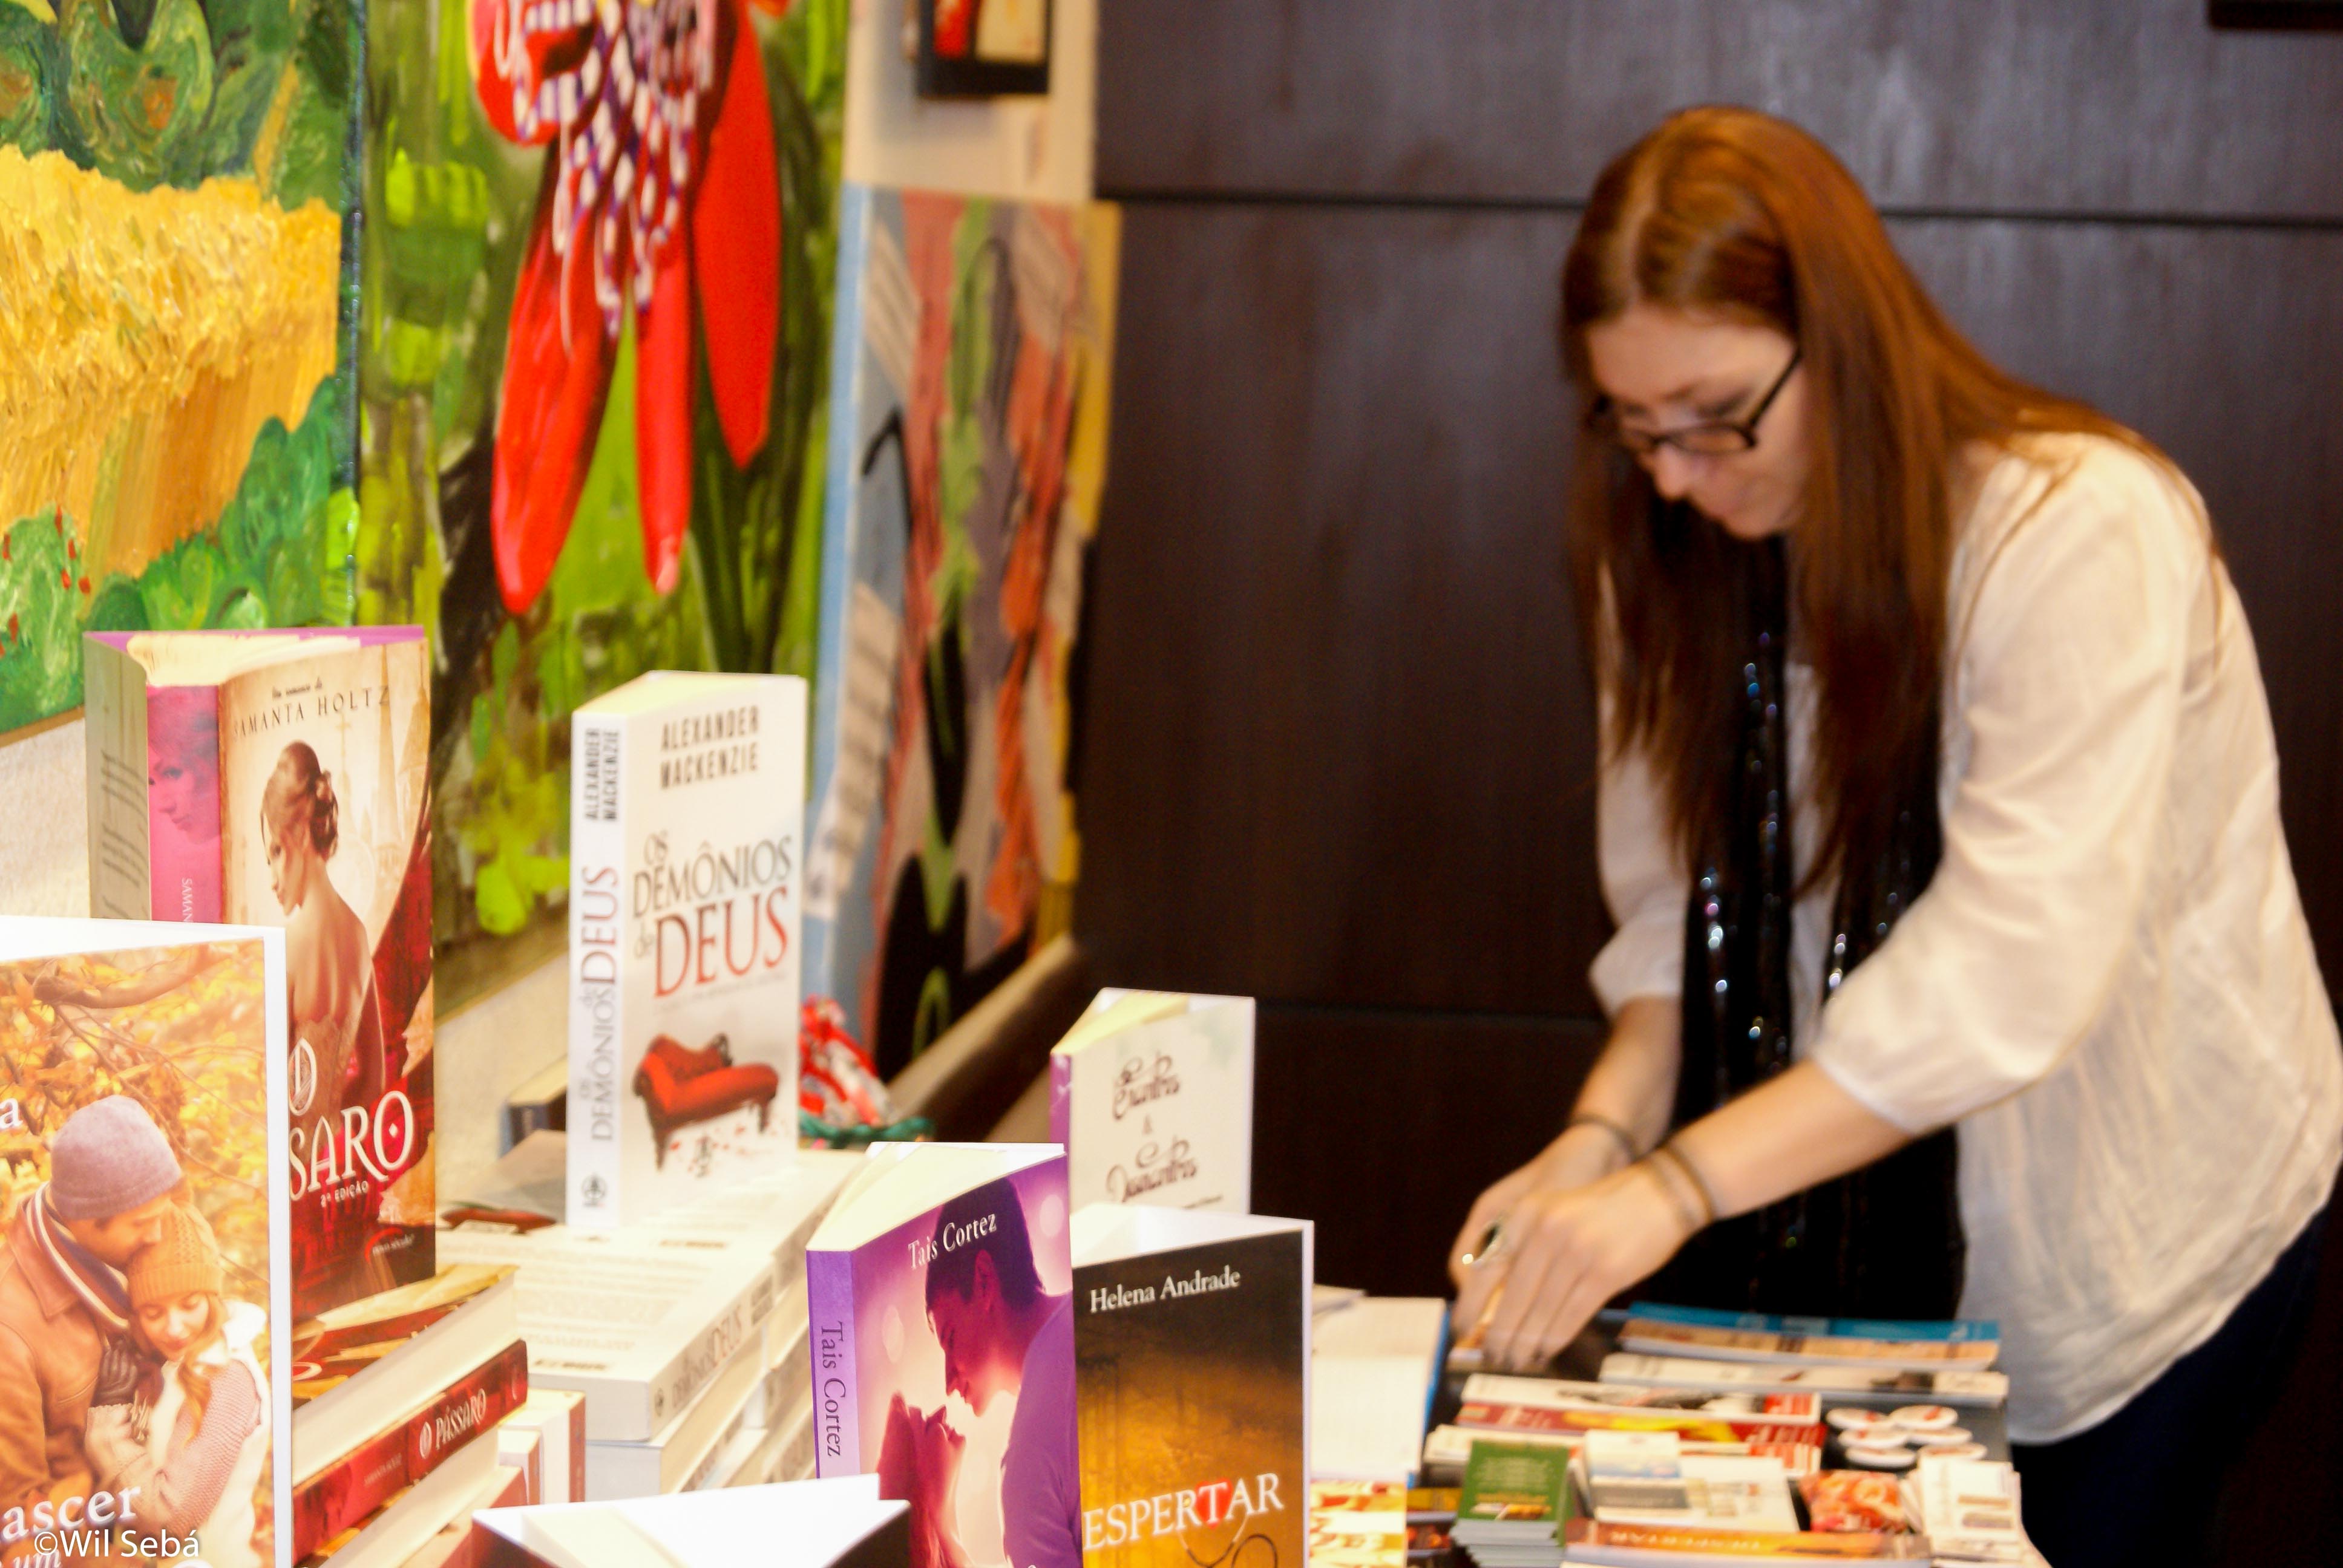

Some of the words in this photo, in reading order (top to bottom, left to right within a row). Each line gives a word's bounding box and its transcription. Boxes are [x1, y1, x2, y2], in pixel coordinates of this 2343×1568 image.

[234, 702, 304, 739] SAMANTA
[318, 685, 389, 716] HOLTZ
[661, 705, 759, 752] ALEXANDER
[585, 729, 600, 820] ALEXANDER
[603, 731, 619, 820] MACKENZIE
[660, 742, 759, 789] MACKENZIE
[634, 834, 792, 918] DEMÔNIOS
[581, 865, 618, 984] DEUS
[654, 884, 788, 998] DEUS
[588, 987, 616, 1141] DEMÔNIOS
[335, 1180, 369, 1203] EDIÇÃO
[908, 1236, 938, 1270] Tais
[943, 1213, 997, 1252] Cortez
[1090, 1283, 1156, 1314] Helena
[1160, 1264, 1241, 1300] Andrade
[821, 1321, 844, 1369] Tais
[435, 1388, 486, 1451] PÁSSARO
[824, 1377, 846, 1457] Cortez
[1083, 1472, 1285, 1552] ESPERTAR
